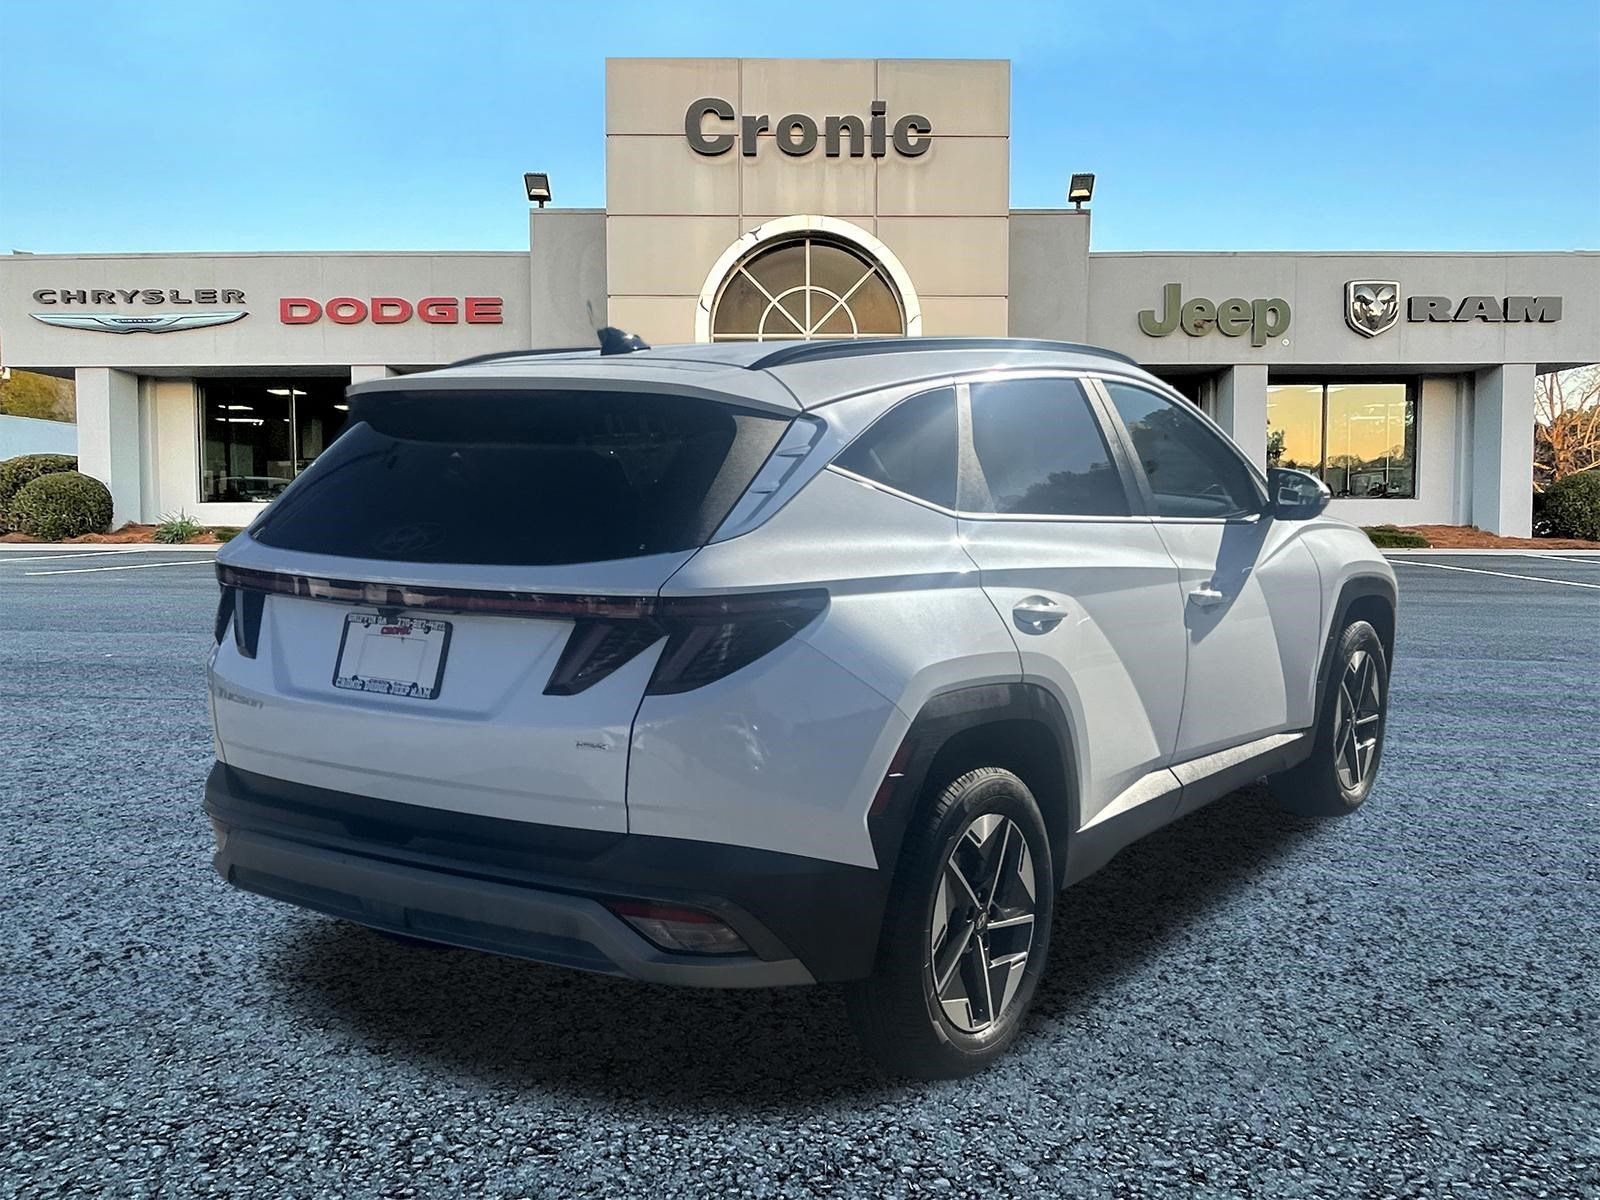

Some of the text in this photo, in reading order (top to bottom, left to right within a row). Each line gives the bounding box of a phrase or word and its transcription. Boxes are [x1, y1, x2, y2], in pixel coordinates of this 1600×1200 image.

[684, 97, 932, 157] Cronic
[32, 288, 246, 304] CHRYSLER
[1407, 296, 1563, 322] RAM
[279, 297, 503, 324] DODGE
[1138, 283, 1291, 347] Jeep
